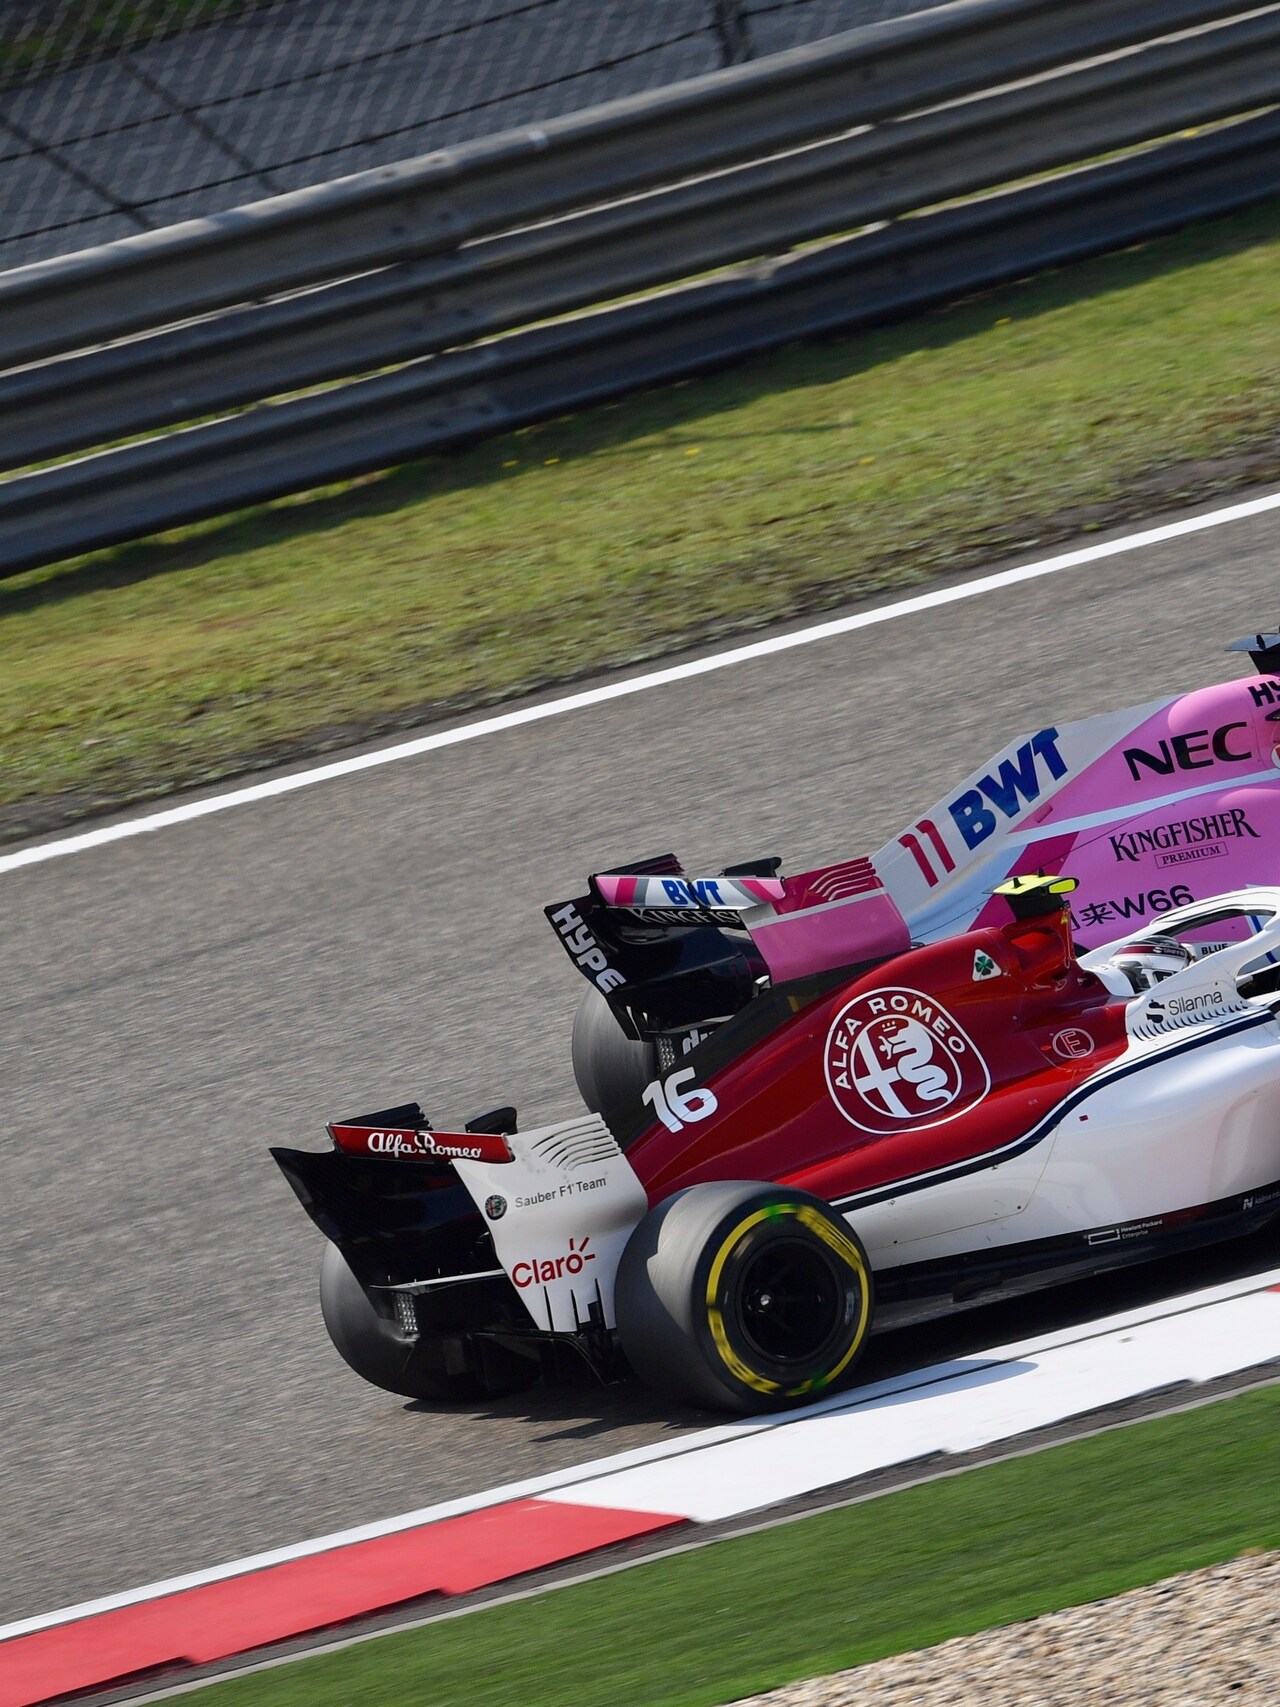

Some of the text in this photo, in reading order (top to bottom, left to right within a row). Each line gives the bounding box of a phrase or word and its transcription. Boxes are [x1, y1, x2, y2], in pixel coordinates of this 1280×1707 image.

[1122, 721, 1252, 781] NEC
[947, 727, 1068, 851] BWT
[897, 819, 957, 888] 11
[1108, 808, 1261, 863] KINGFISHER
[1162, 845, 1222, 866] PREMIUM
[660, 879, 727, 906] BWT
[551, 902, 627, 995] HYPE
[1168, 990, 1223, 1016] Silanna
[832, 995, 966, 1090] ALFA ROMEO
[642, 1066, 718, 1133] 16
[367, 1131, 482, 1159] Alfa Romeo
[515, 1190, 557, 1208] Sauber
[576, 1177, 607, 1193] Team
[1121, 1222, 1142, 1233] Hewlett
[512, 1243, 591, 1288] Claro
